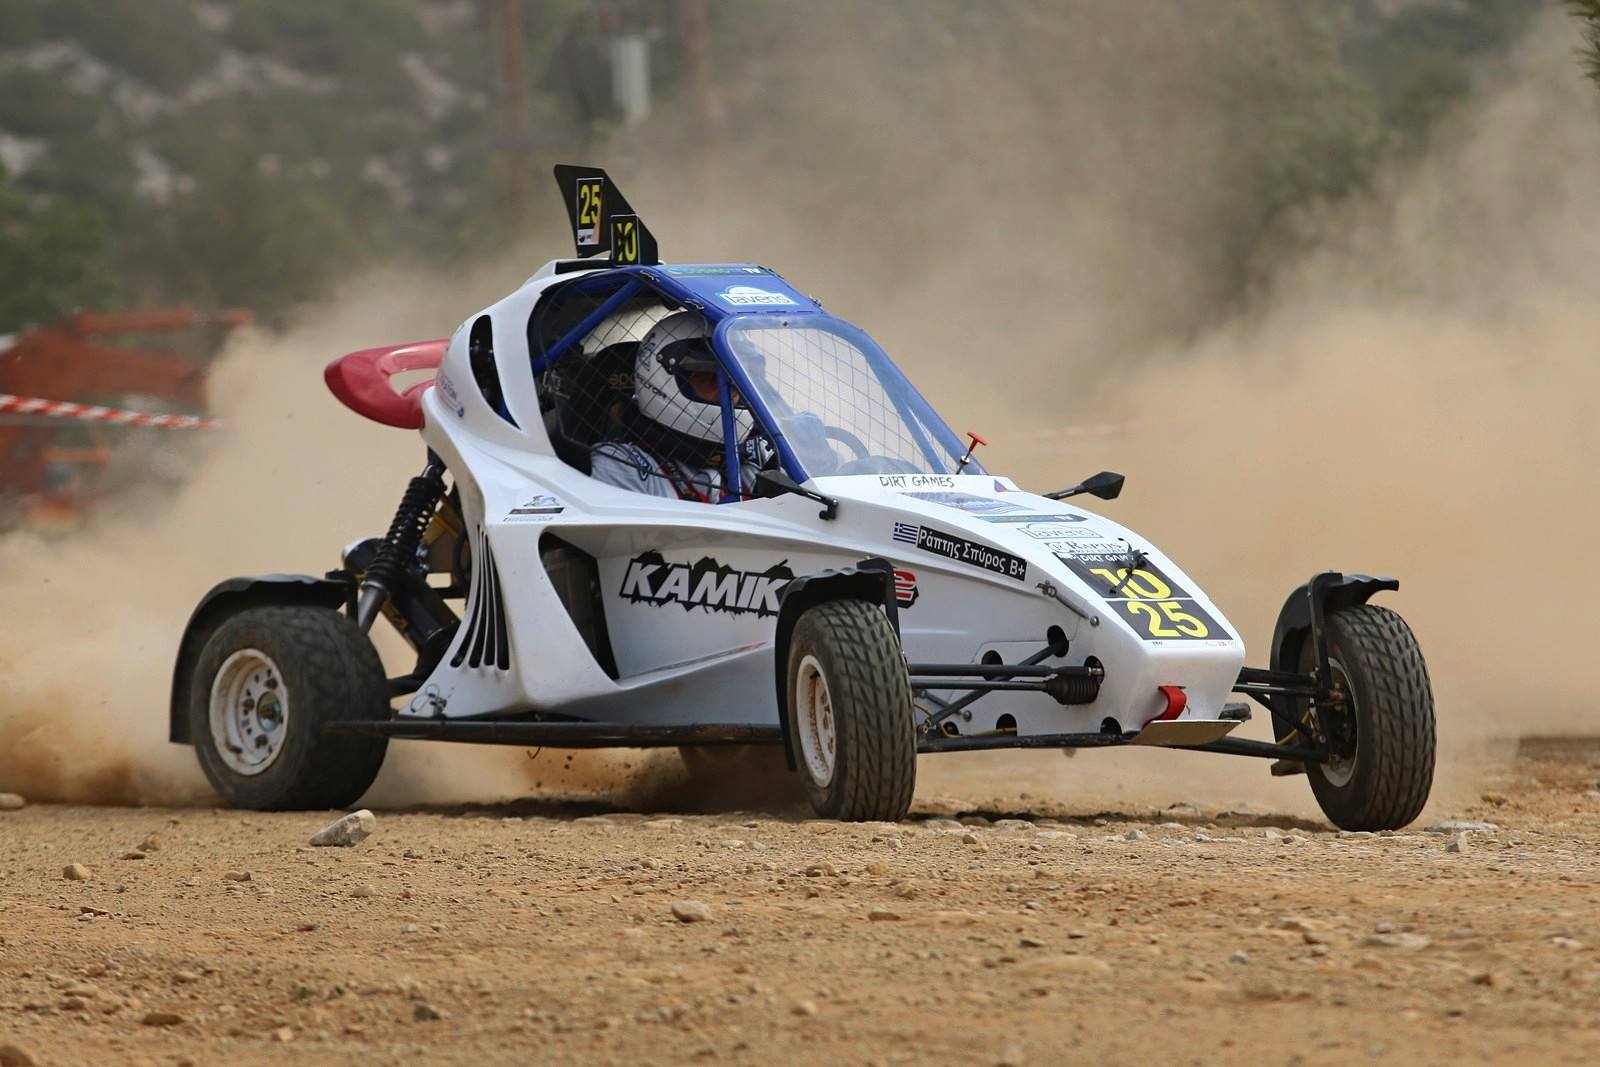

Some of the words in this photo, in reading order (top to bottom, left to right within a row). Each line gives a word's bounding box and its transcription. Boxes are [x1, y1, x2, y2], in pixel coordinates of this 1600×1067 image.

[580, 184, 601, 224] 25
[726, 293, 791, 304] lavens
[879, 476, 907, 488] DIRT
[911, 475, 955, 488] GAMES
[917, 528, 961, 559] Ράπτης
[962, 544, 1006, 575] Σπύρος
[623, 561, 794, 612] KAMIK
[1089, 567, 1172, 599] 10
[1126, 601, 1208, 638] 25
